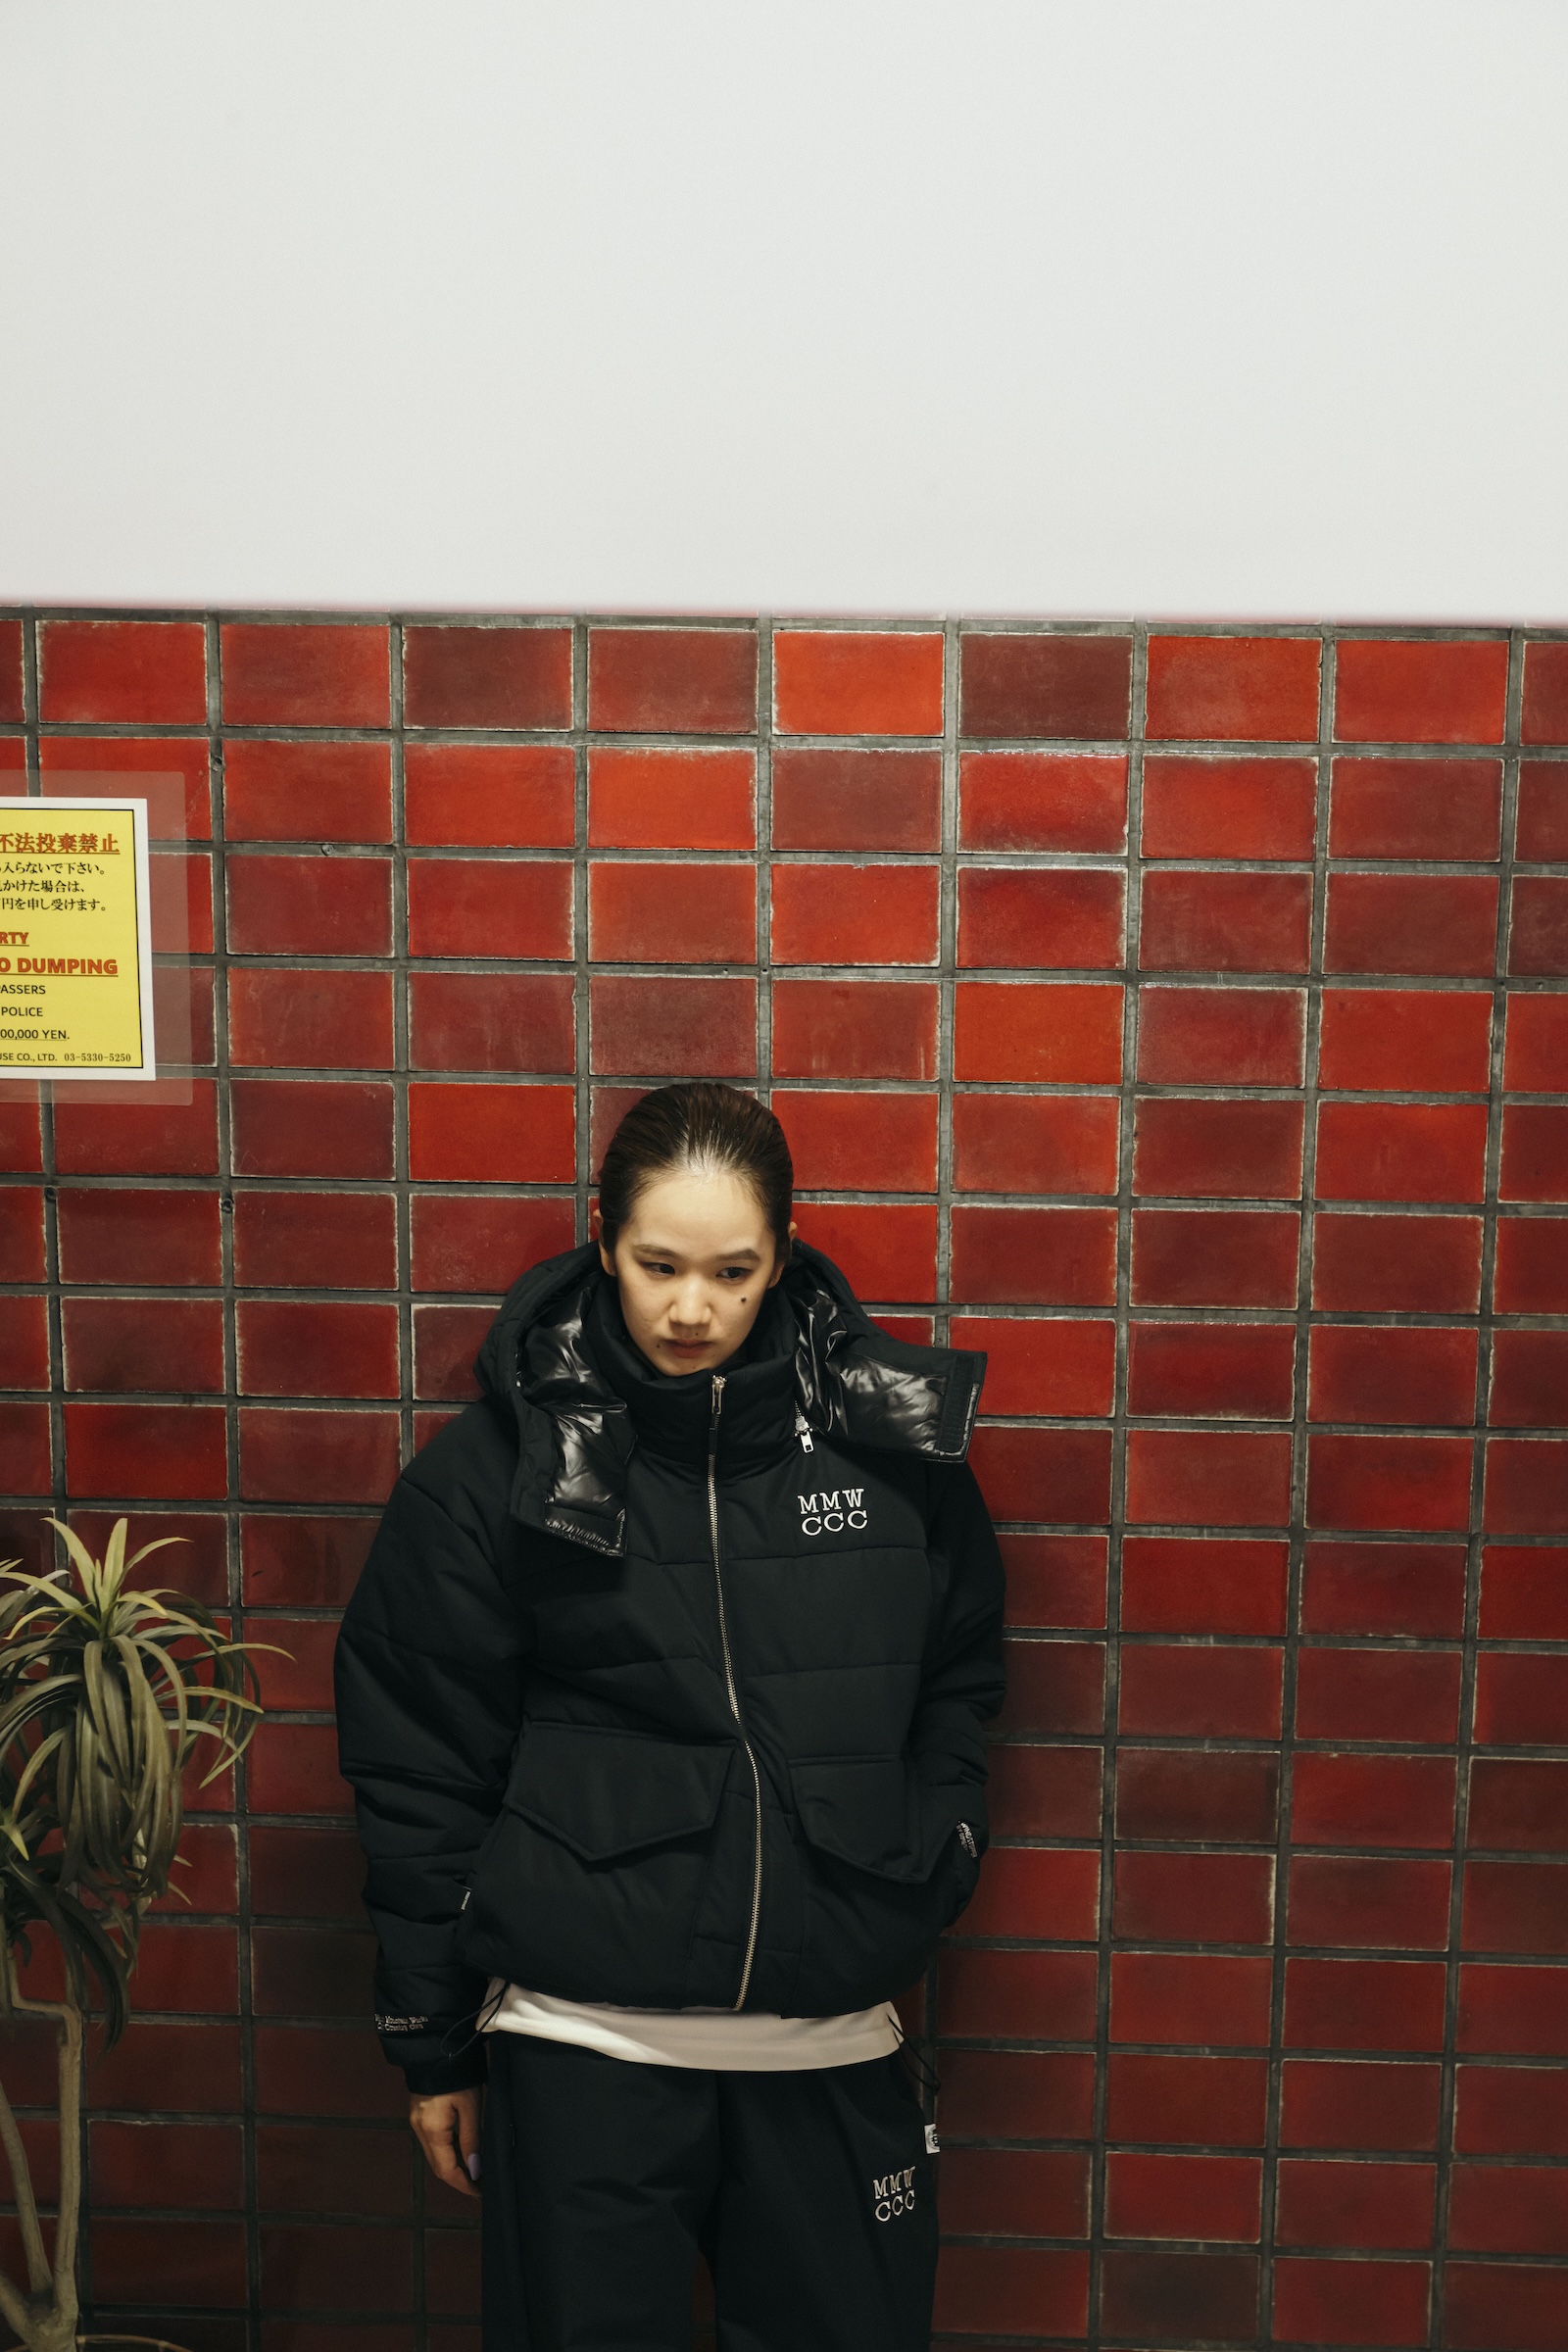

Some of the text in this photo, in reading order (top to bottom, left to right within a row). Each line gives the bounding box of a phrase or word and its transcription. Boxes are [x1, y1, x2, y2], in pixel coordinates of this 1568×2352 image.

[0, 861, 105, 875] 入らないで下さい。
[17, 957, 119, 975] DUMPING
[0, 984, 46, 995] ASSERS
[1, 1006, 43, 1017] POLICE
[42, 1030, 70, 1040] YEN.
[17, 1053, 35, 1062] CO.,
[37, 1053, 57, 1061] LTD.
[64, 1053, 131, 1062] 03-5330-5250
[797, 1488, 864, 1515] MMW
[801, 1509, 868, 1537] CCC
[872, 2165, 916, 2200] MMW
[874, 2189, 915, 2223] CCC
